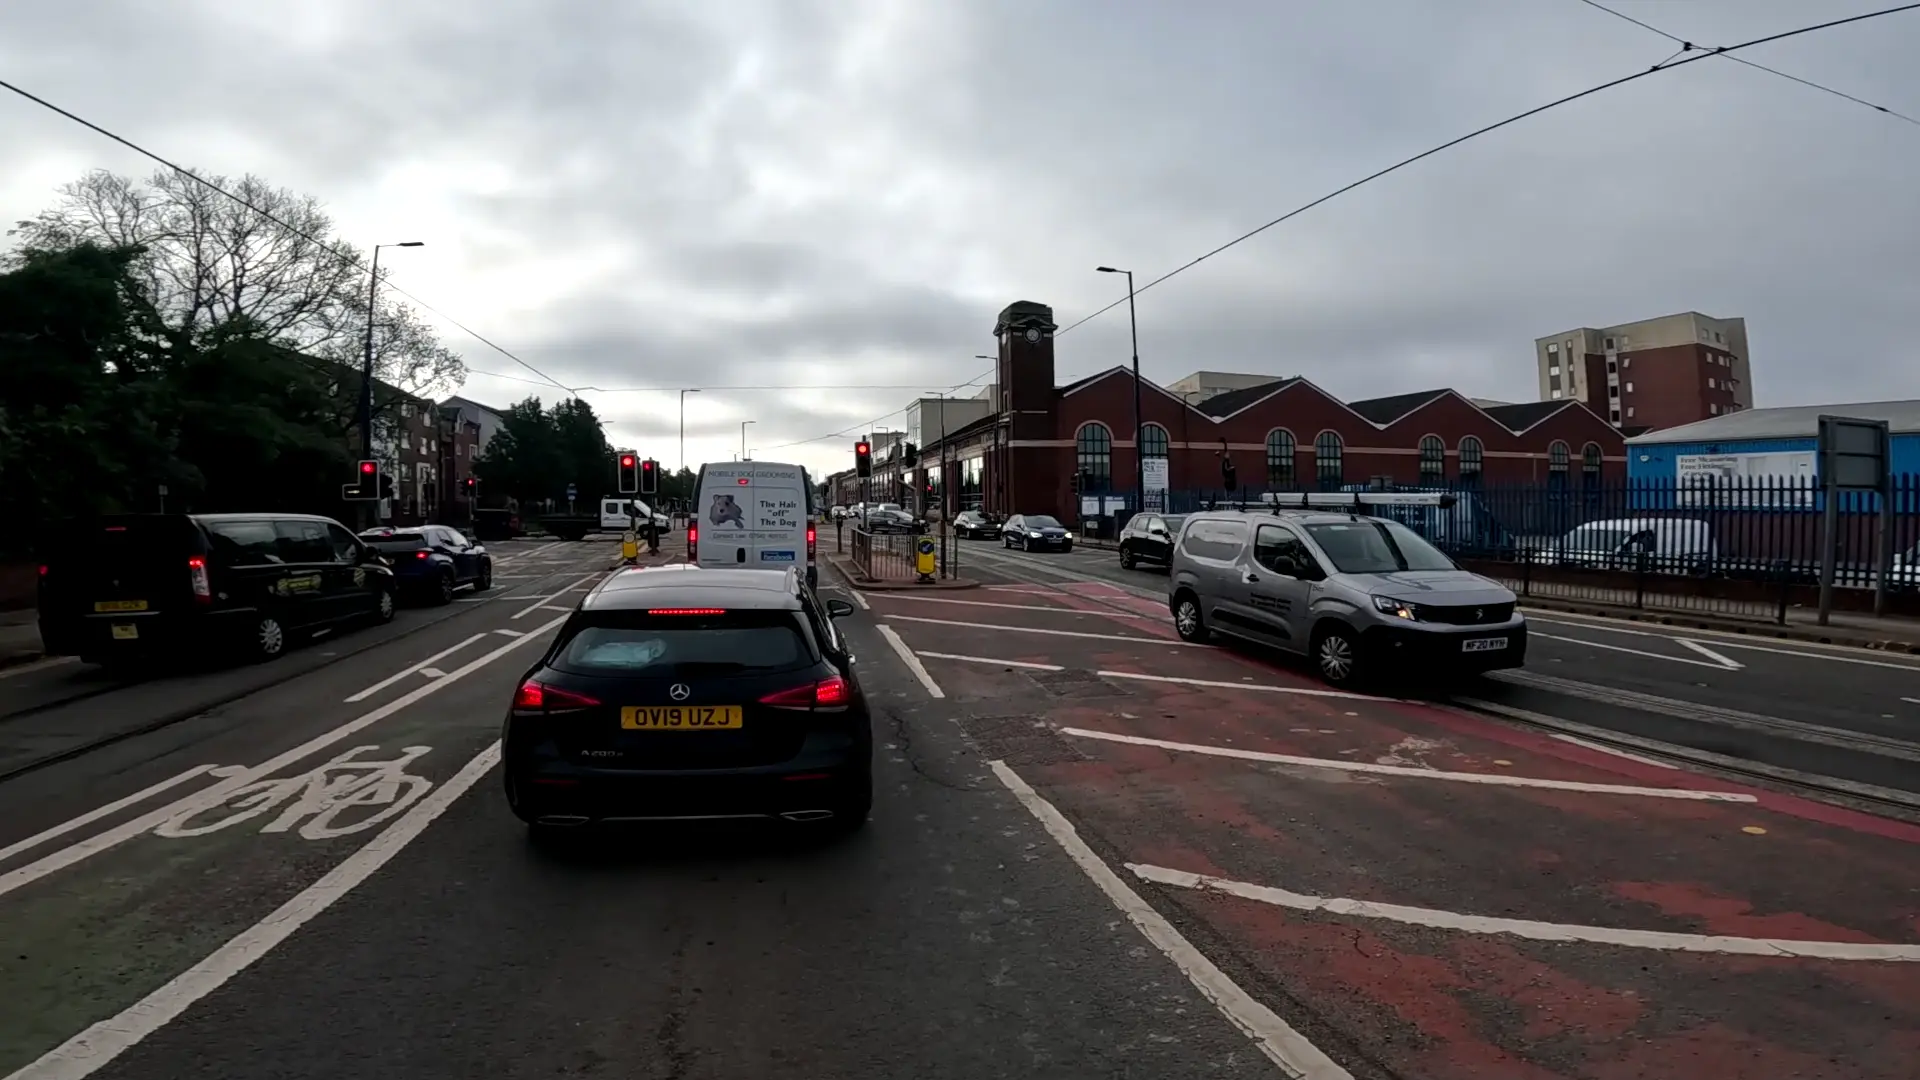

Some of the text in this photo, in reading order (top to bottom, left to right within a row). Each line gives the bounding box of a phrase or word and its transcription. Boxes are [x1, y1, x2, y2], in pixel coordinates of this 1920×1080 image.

[708, 470, 735, 478] MOBILE
[756, 471, 796, 479] GROOMING
[760, 500, 797, 509] The Hair
[767, 509, 790, 517] "off"
[760, 518, 797, 528] The Dog
[635, 708, 730, 727] OV19 UZJ
